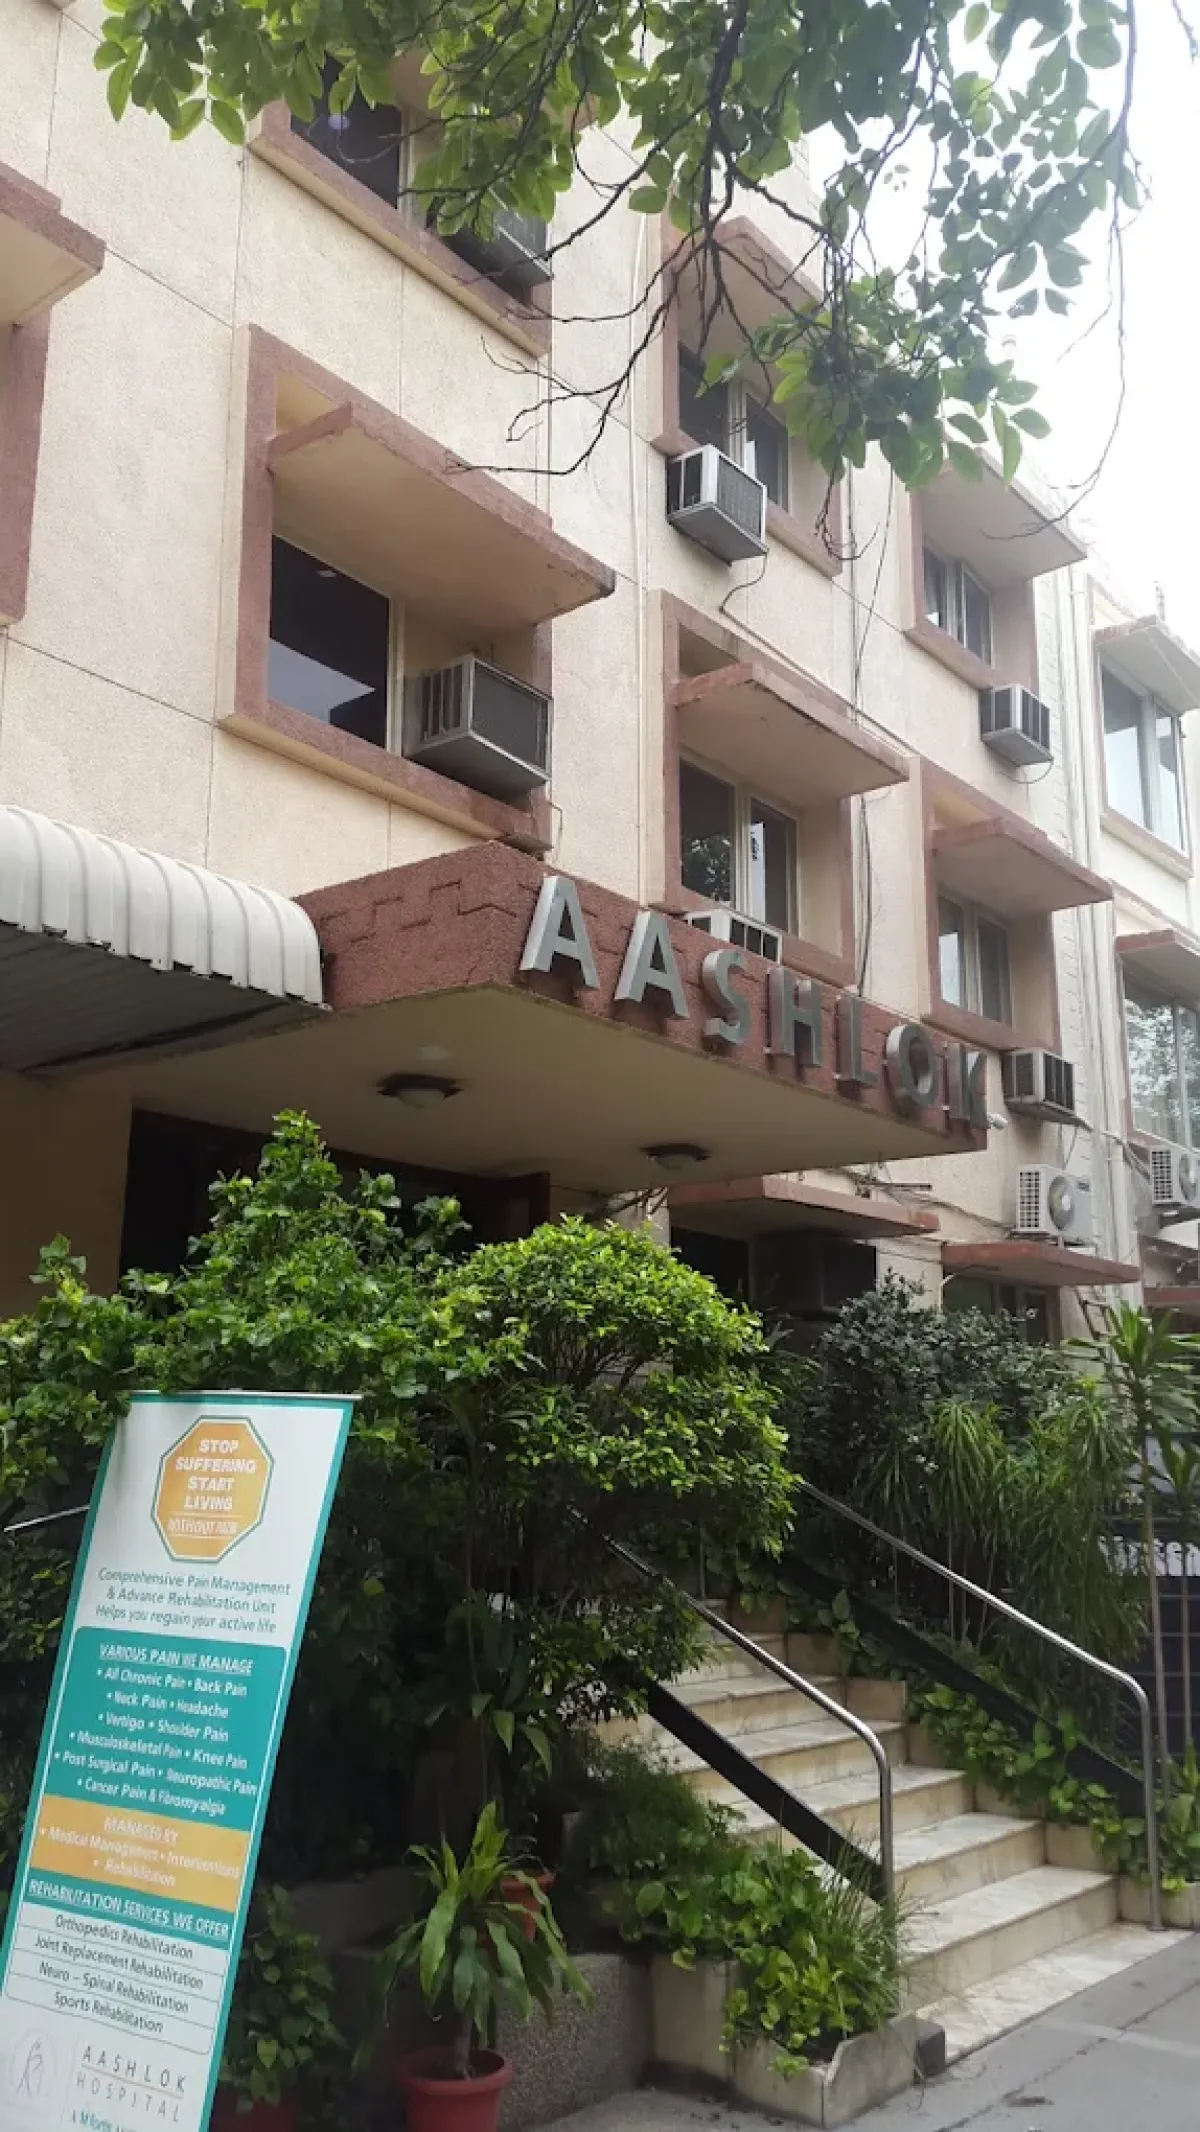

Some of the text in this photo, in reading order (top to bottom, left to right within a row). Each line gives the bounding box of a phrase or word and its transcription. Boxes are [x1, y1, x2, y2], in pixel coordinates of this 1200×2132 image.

[520, 875, 990, 1130] AASHLOK
[200, 1438, 239, 1453] STOP
[175, 1456, 256, 1473] SUFFERING
[188, 1475, 235, 1491] START
[184, 1495, 233, 1510] LIVING
[98, 1567, 291, 1596] Comprehensive Pain Management
[106, 1586, 277, 1615] & Advance Rehabilitation Unit
[96, 1604, 277, 1634] Helps you regain your active life
[100, 1643, 147, 1662] VARIOUS
[150, 1648, 181, 1666] PAIN
[199, 1654, 255, 1674] MANAGE
[103, 1667, 248, 1697] All Chronic Pain Back Pain
[114, 1690, 229, 1719] Neck Pain Headache
[106, 1711, 229, 1742] Vertigo Shoulder Pain
[162, 1743, 183, 1759] Pain
[192, 1749, 225, 1767] Knee
[226, 1753, 248, 1769] Pain
[62, 1750, 258, 1796] Post Surgical Pain Neuropathic Pain
[85, 1777, 119, 1796] Cancer
[121, 1783, 147, 1800] Pain
[148, 1787, 157, 1803] &
[28, 1878, 230, 1940] REHABILITATION SERVICES WE OFFER
[55, 1914, 194, 1961] Orthopedics Rehabilitation
[34, 1935, 204, 1990] Joint Replacement Rehabilitation
[39, 1960, 70, 1982] Neuro
[83, 1972, 116, 1994] Spinal
[116, 1979, 189, 2014] Rehabilitation
[54, 1990, 164, 2034] Sports Rehabilitation
[83, 2045, 187, 2094] AASHLOK
[76, 2071, 180, 2122] HOSPITAL
